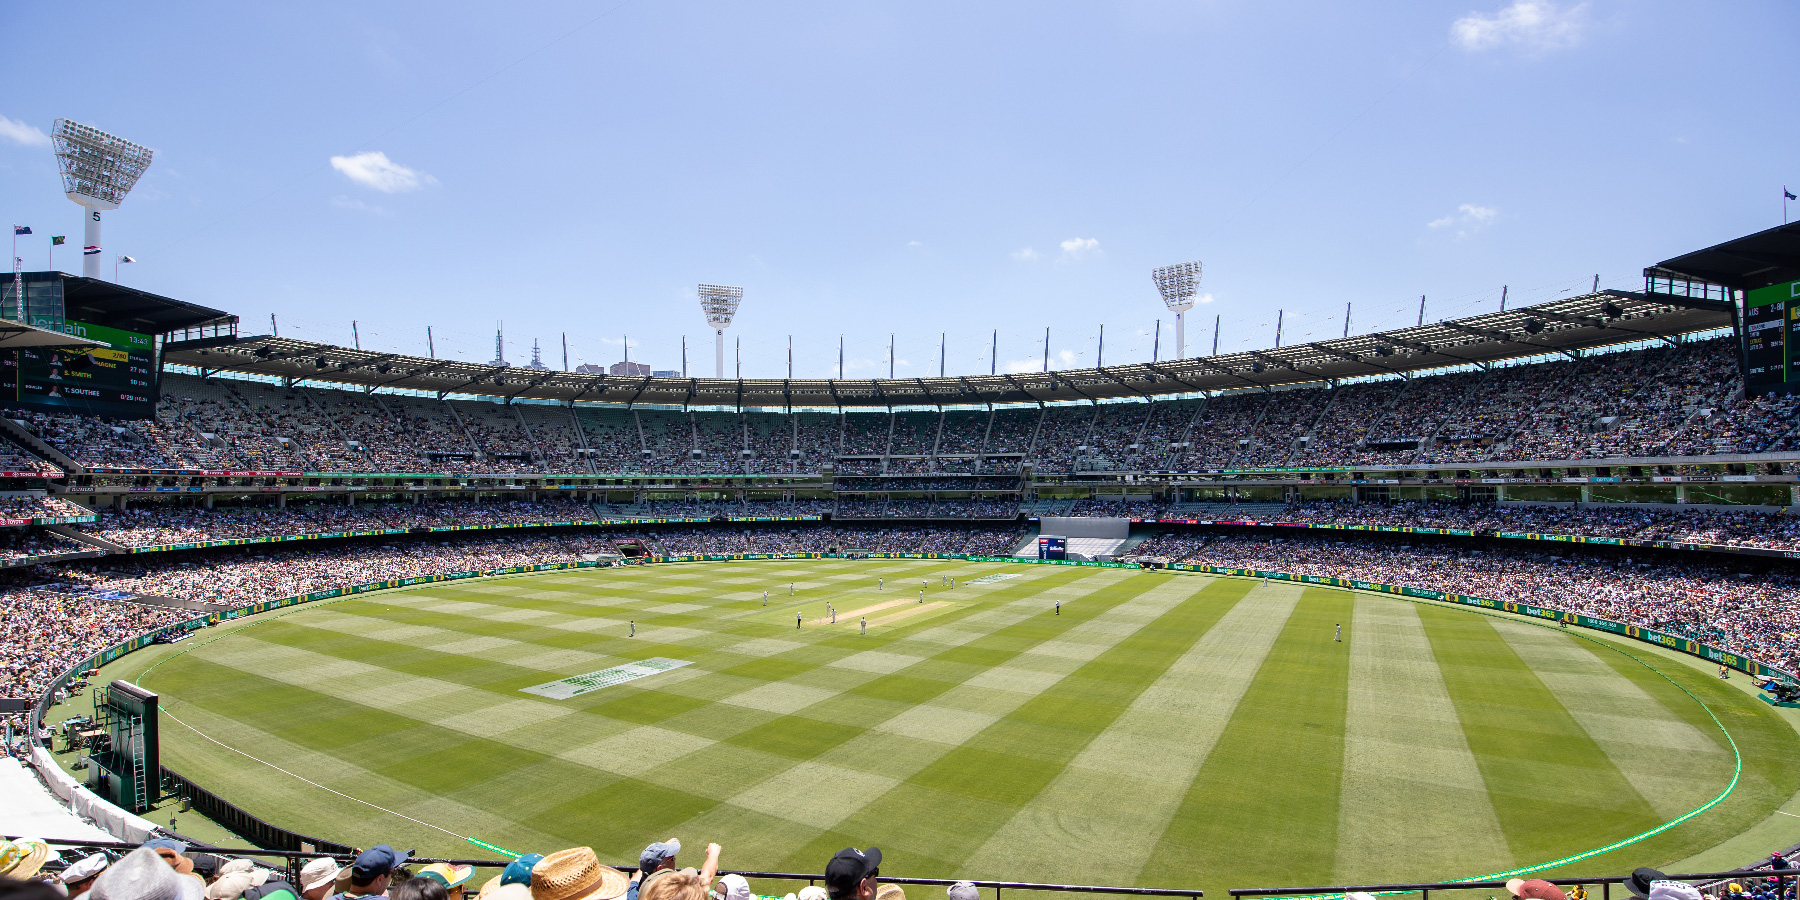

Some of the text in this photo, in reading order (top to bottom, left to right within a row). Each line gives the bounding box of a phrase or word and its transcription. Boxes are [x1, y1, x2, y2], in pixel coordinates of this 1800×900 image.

[93, 212, 101, 221] 5
[1748, 308, 1760, 317] AUS
[129, 336, 149, 345] 13:43
[71, 371, 92, 379] SMITH
[71, 388, 100, 397] SOUTHEE
[1308, 576, 1331, 584] bet365
[1358, 581, 1382, 591] bet365
[269, 598, 292, 609] bet365
[1466, 597, 1495, 607] bet365
[227, 608, 248, 619] bet365
[1527, 607, 1555, 619] bet365
[1648, 631, 1676, 647] bet365
[107, 647, 124, 661] bet365
[1709, 648, 1738, 666] bet365
